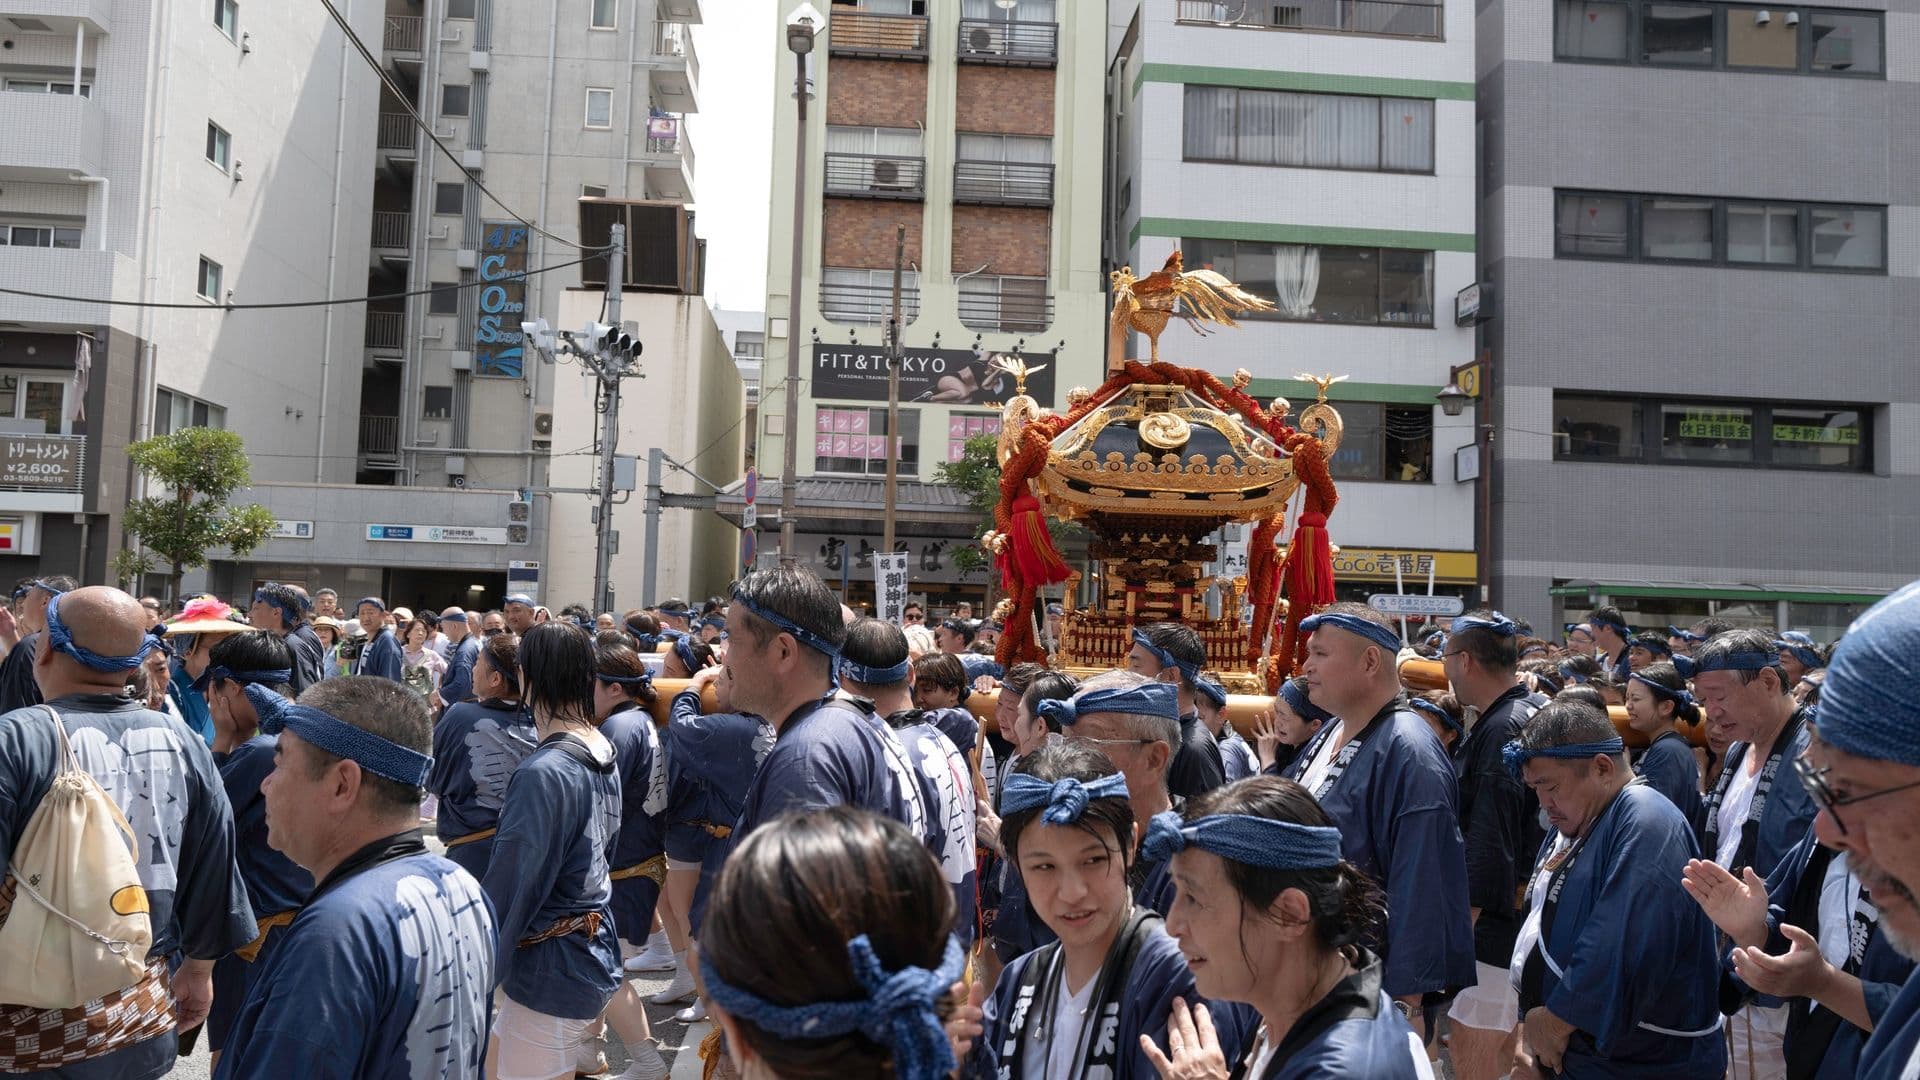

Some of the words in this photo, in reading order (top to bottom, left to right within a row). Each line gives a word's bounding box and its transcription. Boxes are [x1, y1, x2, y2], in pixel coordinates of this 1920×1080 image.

[487, 228, 526, 249] 4F
[480, 286, 523, 314] One
[837, 373, 865, 381] PERSONAL
[819, 415, 865, 430] キック
[9, 442, 69, 459] トリートメント
[818, 439, 901, 453] ボクシン
[1333, 553, 1434, 574] CoCo壱番屋
